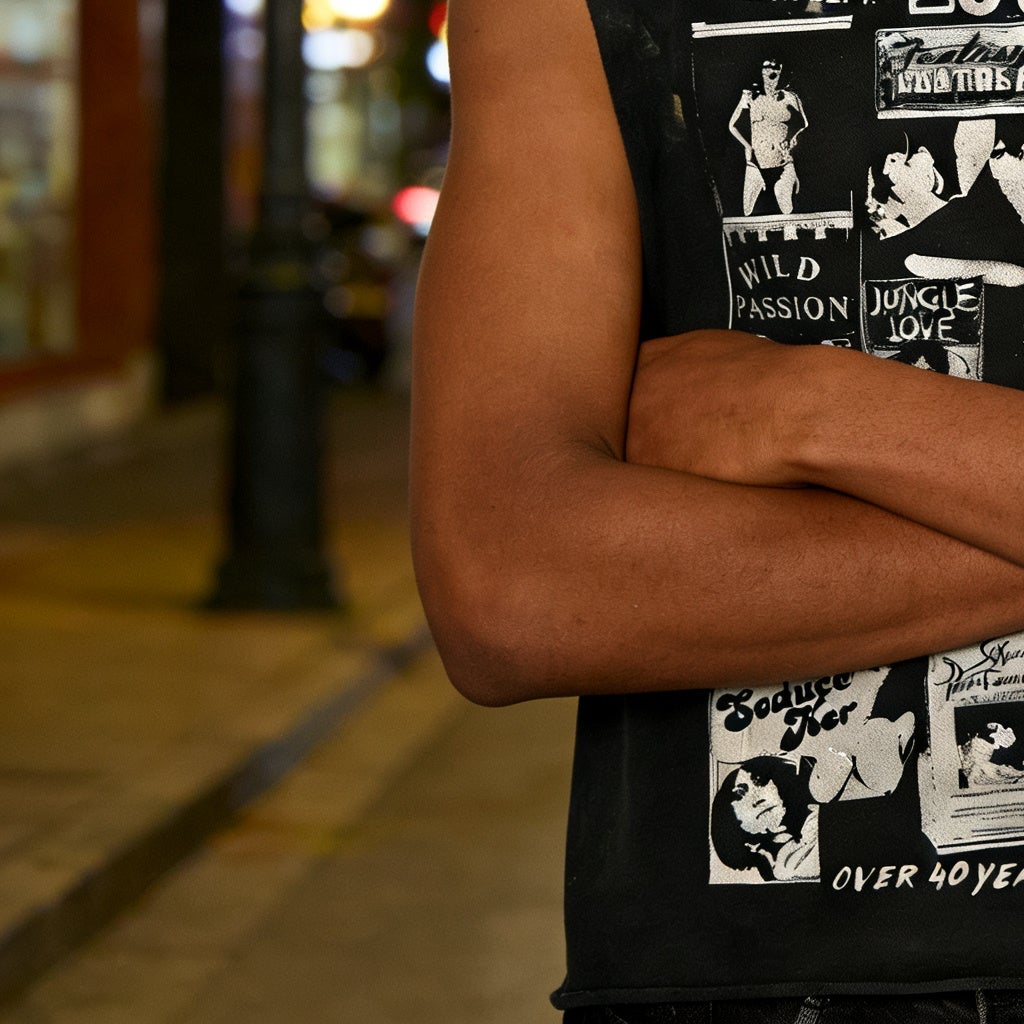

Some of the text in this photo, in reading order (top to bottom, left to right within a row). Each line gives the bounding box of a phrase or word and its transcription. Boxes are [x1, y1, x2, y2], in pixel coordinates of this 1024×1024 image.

[738, 254, 821, 290] WILD
[736, 295, 848, 322] PASSION
[869, 280, 981, 316] JUNGLE
[832, 863, 919, 892] OVER
[928, 860, 970, 891] 40
